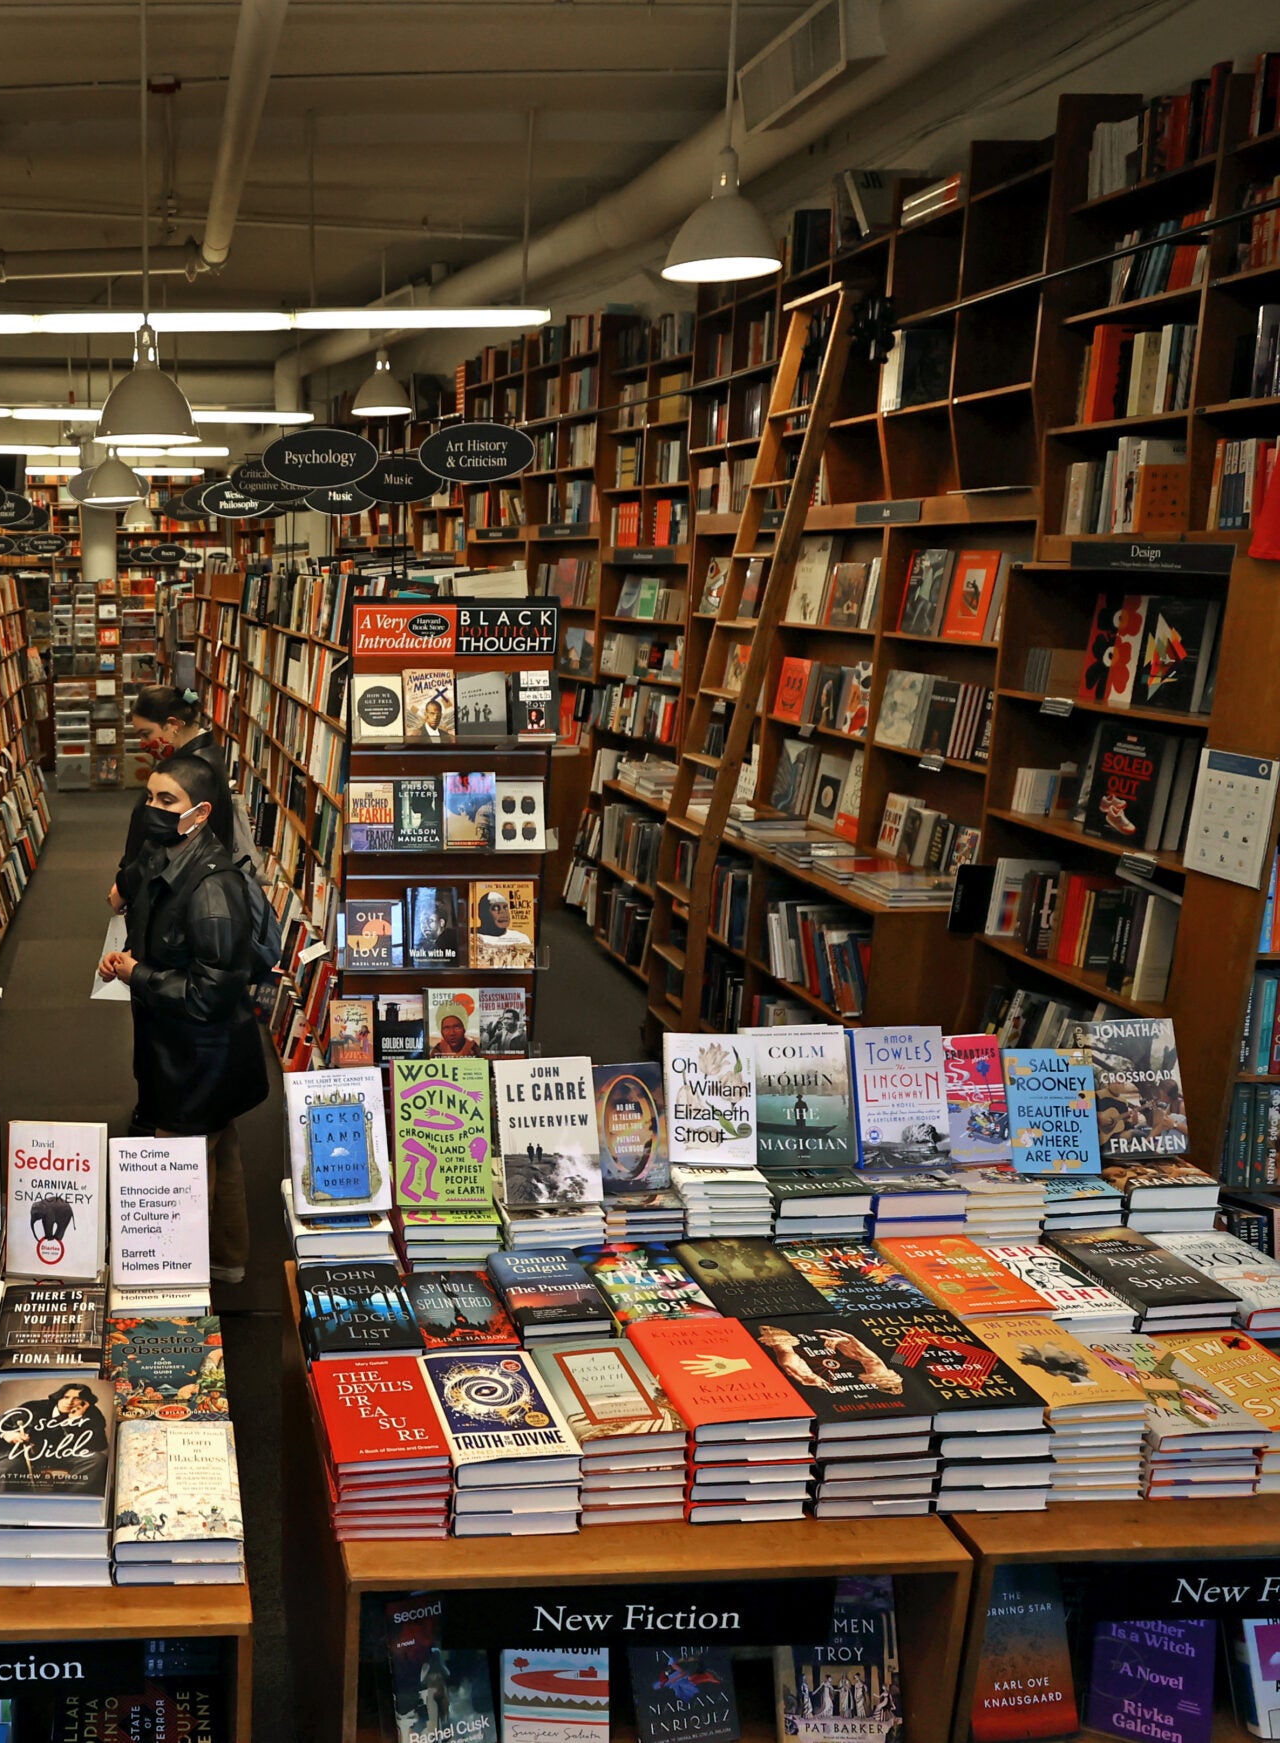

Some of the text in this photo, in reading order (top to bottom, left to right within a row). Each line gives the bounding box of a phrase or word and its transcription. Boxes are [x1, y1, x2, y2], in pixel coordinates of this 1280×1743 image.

[446, 439, 508, 452] Art History
[284, 451, 357, 466] Psychology
[446, 455, 507, 468] & Criticism
[384, 474, 413, 485] Music
[328, 491, 352, 501] Music
[220, 501, 259, 510] Philosophy
[1131, 545, 1161, 561] Design
[360, 615, 407, 630] A Very
[460, 611, 552, 626] BLACK
[461, 627, 551, 637] POLITICAL
[358, 635, 452, 649] Introduction
[460, 637, 552, 651] THOUGHT
[407, 672, 450, 684] AWAKENING
[414, 679, 453, 693] MALCOLM
[1101, 753, 1154, 776] SOLED
[1107, 777, 1140, 796] OUT
[398, 790, 438, 798] LETTERS
[356, 912, 384, 922] OUT
[353, 948, 388, 958] LOVE
[410, 949, 456, 958] Walk with Me
[1093, 1022, 1172, 1039] JONATHAN
[768, 1045, 825, 1059] COLM
[530, 1067, 559, 1078] JOHN
[672, 1057, 697, 1074] Oh
[1029, 1059, 1070, 1073] SALLY
[397, 1064, 458, 1082] WOLE
[506, 1077, 586, 1102] LE CARRÉ
[689, 1081, 751, 1097] William!
[1016, 1077, 1086, 1091] ROONEY
[400, 1090, 485, 1122] SOYINKA
[674, 1104, 749, 1122] Elizabeth
[509, 1114, 589, 1129] SILVERVIEW
[674, 1126, 726, 1143] Strout
[31, 1139, 54, 1148] David
[759, 1138, 848, 1151] MAGICIAN
[1110, 1135, 1187, 1153] FRANZEN
[14, 1149, 90, 1172] Sedaris
[119, 1150, 169, 1159] The Crime
[119, 1163, 158, 1171] Without
[170, 1162, 198, 1171] Name
[31, 1179, 77, 1190] CARNIVAL
[122, 1261, 192, 1271] Holmes Pitner
[1106, 1253, 1162, 1270] April
[326, 1270, 376, 1282] JOHN
[1128, 1272, 1199, 1290] Spain
[311, 1284, 402, 1296] GRISHAM
[12, 1353, 84, 1364] FIONA HILL
[8, 1430, 96, 1461] Wilde
[452, 1430, 566, 1450] TRUTH DIVINE
[1171, 1578, 1250, 1603] New
[392, 1602, 442, 1624] second
[532, 1605, 741, 1632] New Fiction
[984, 1692, 1062, 1708] KNAUSGAARD
[804, 1723, 884, 1734] PAT BARKER
